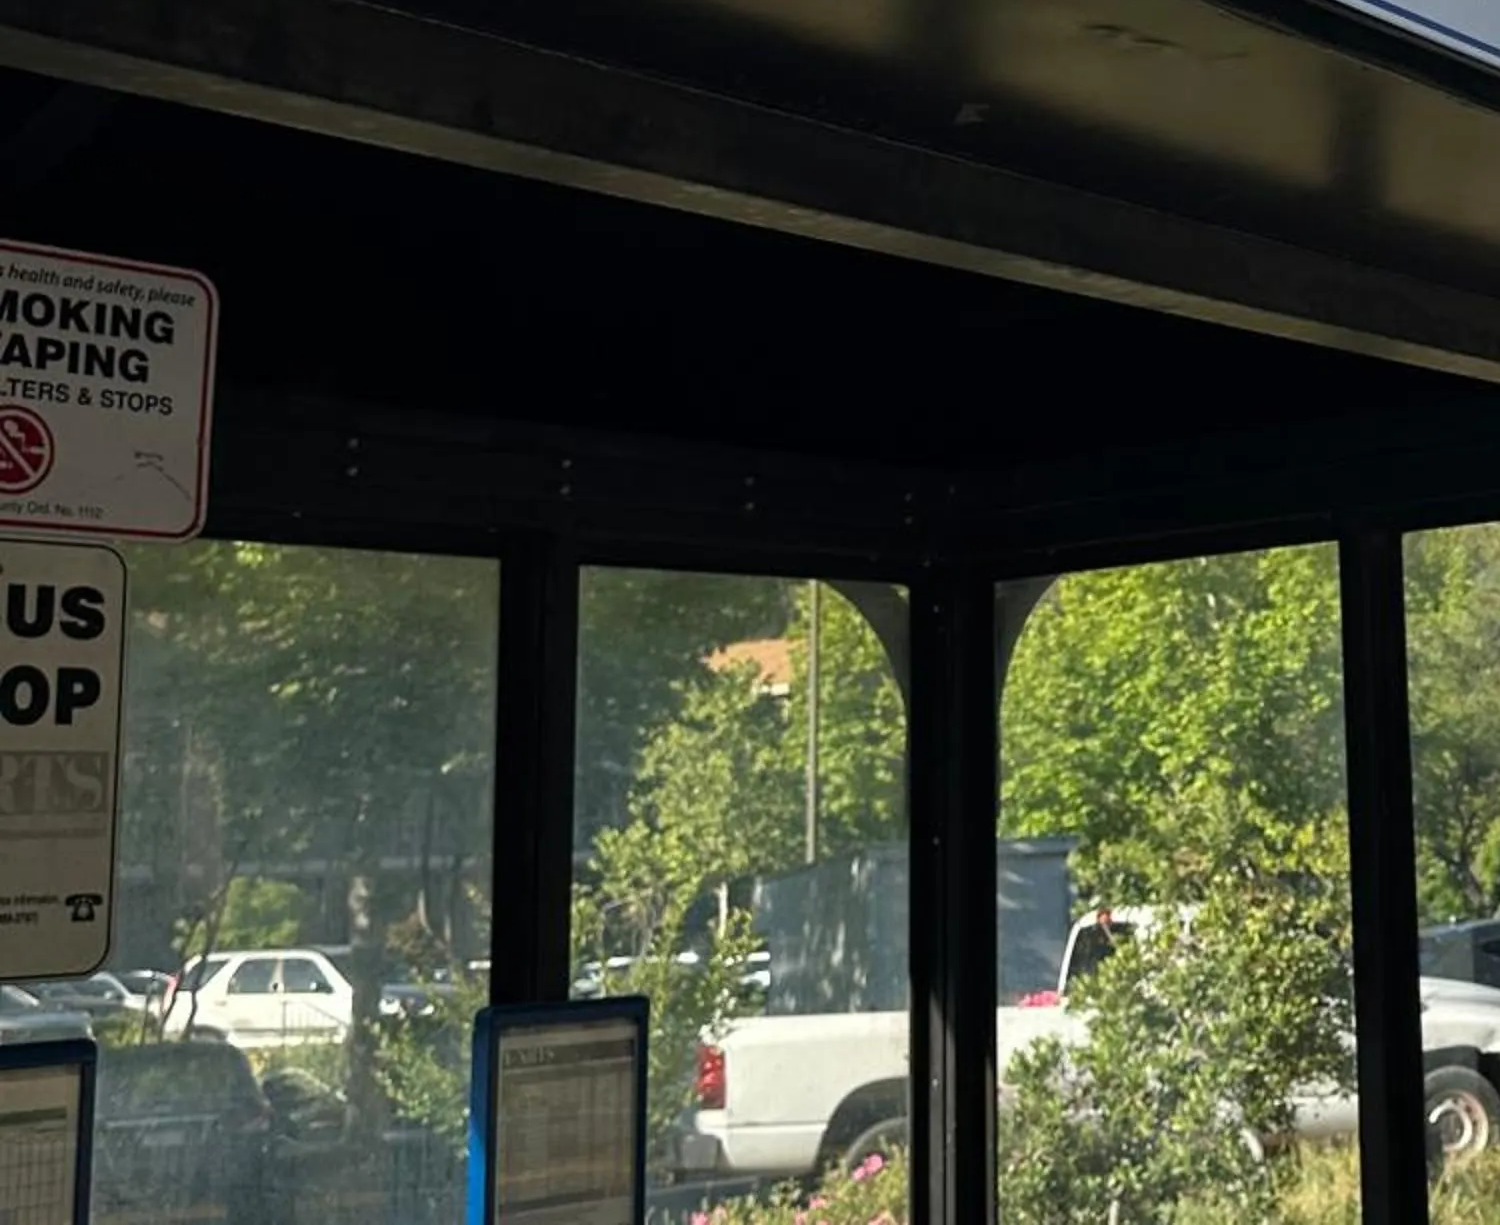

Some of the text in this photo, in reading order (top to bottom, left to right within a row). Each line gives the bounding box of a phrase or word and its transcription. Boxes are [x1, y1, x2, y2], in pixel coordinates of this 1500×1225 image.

[8, 265, 59, 286] health
[63, 273, 94, 291] and
[147, 288, 196, 308] please
[0, 331, 149, 383] APING
[77, 387, 93, 406] &
[100, 389, 174, 417] STOPS
